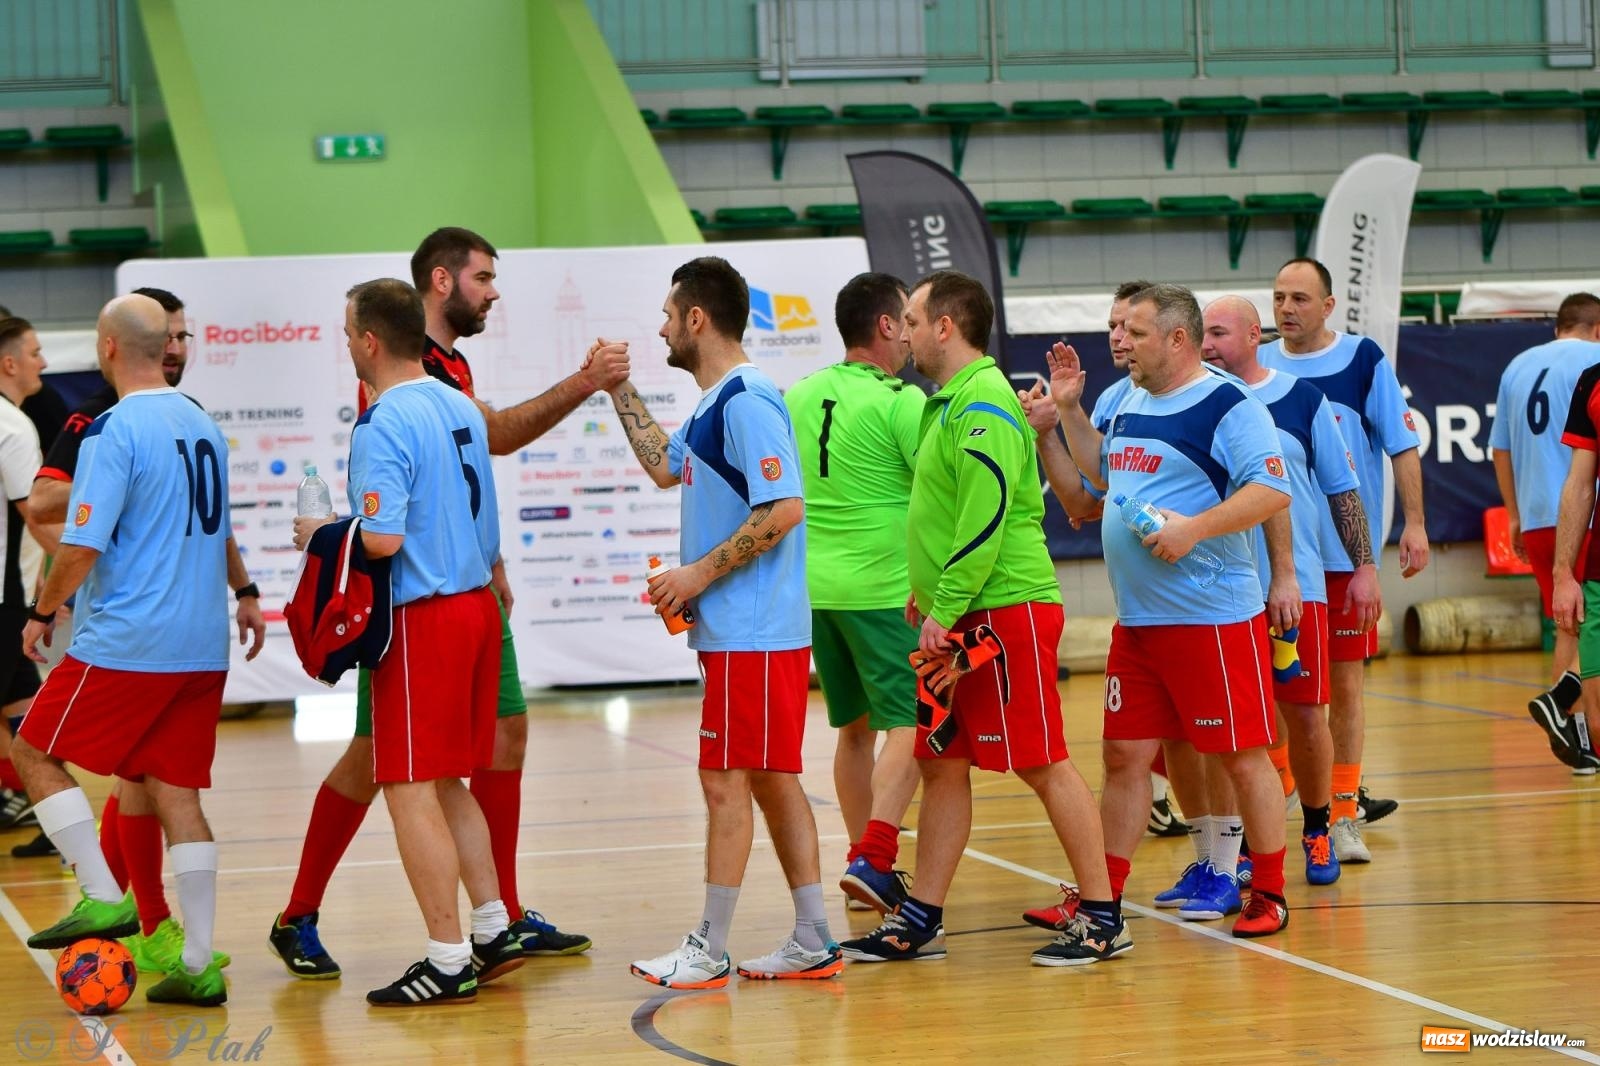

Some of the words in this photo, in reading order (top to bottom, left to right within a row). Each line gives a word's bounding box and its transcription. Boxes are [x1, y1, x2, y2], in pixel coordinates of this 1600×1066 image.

[204, 320, 322, 345] Racibórz
[207, 409, 233, 422] OR
[238, 406, 304, 421] TRENING
[1527, 367, 1550, 436] 6
[819, 398, 838, 478] 1
[175, 438, 223, 537] 10
[451, 426, 481, 521] 5
[1194, 718, 1223, 727] zina
